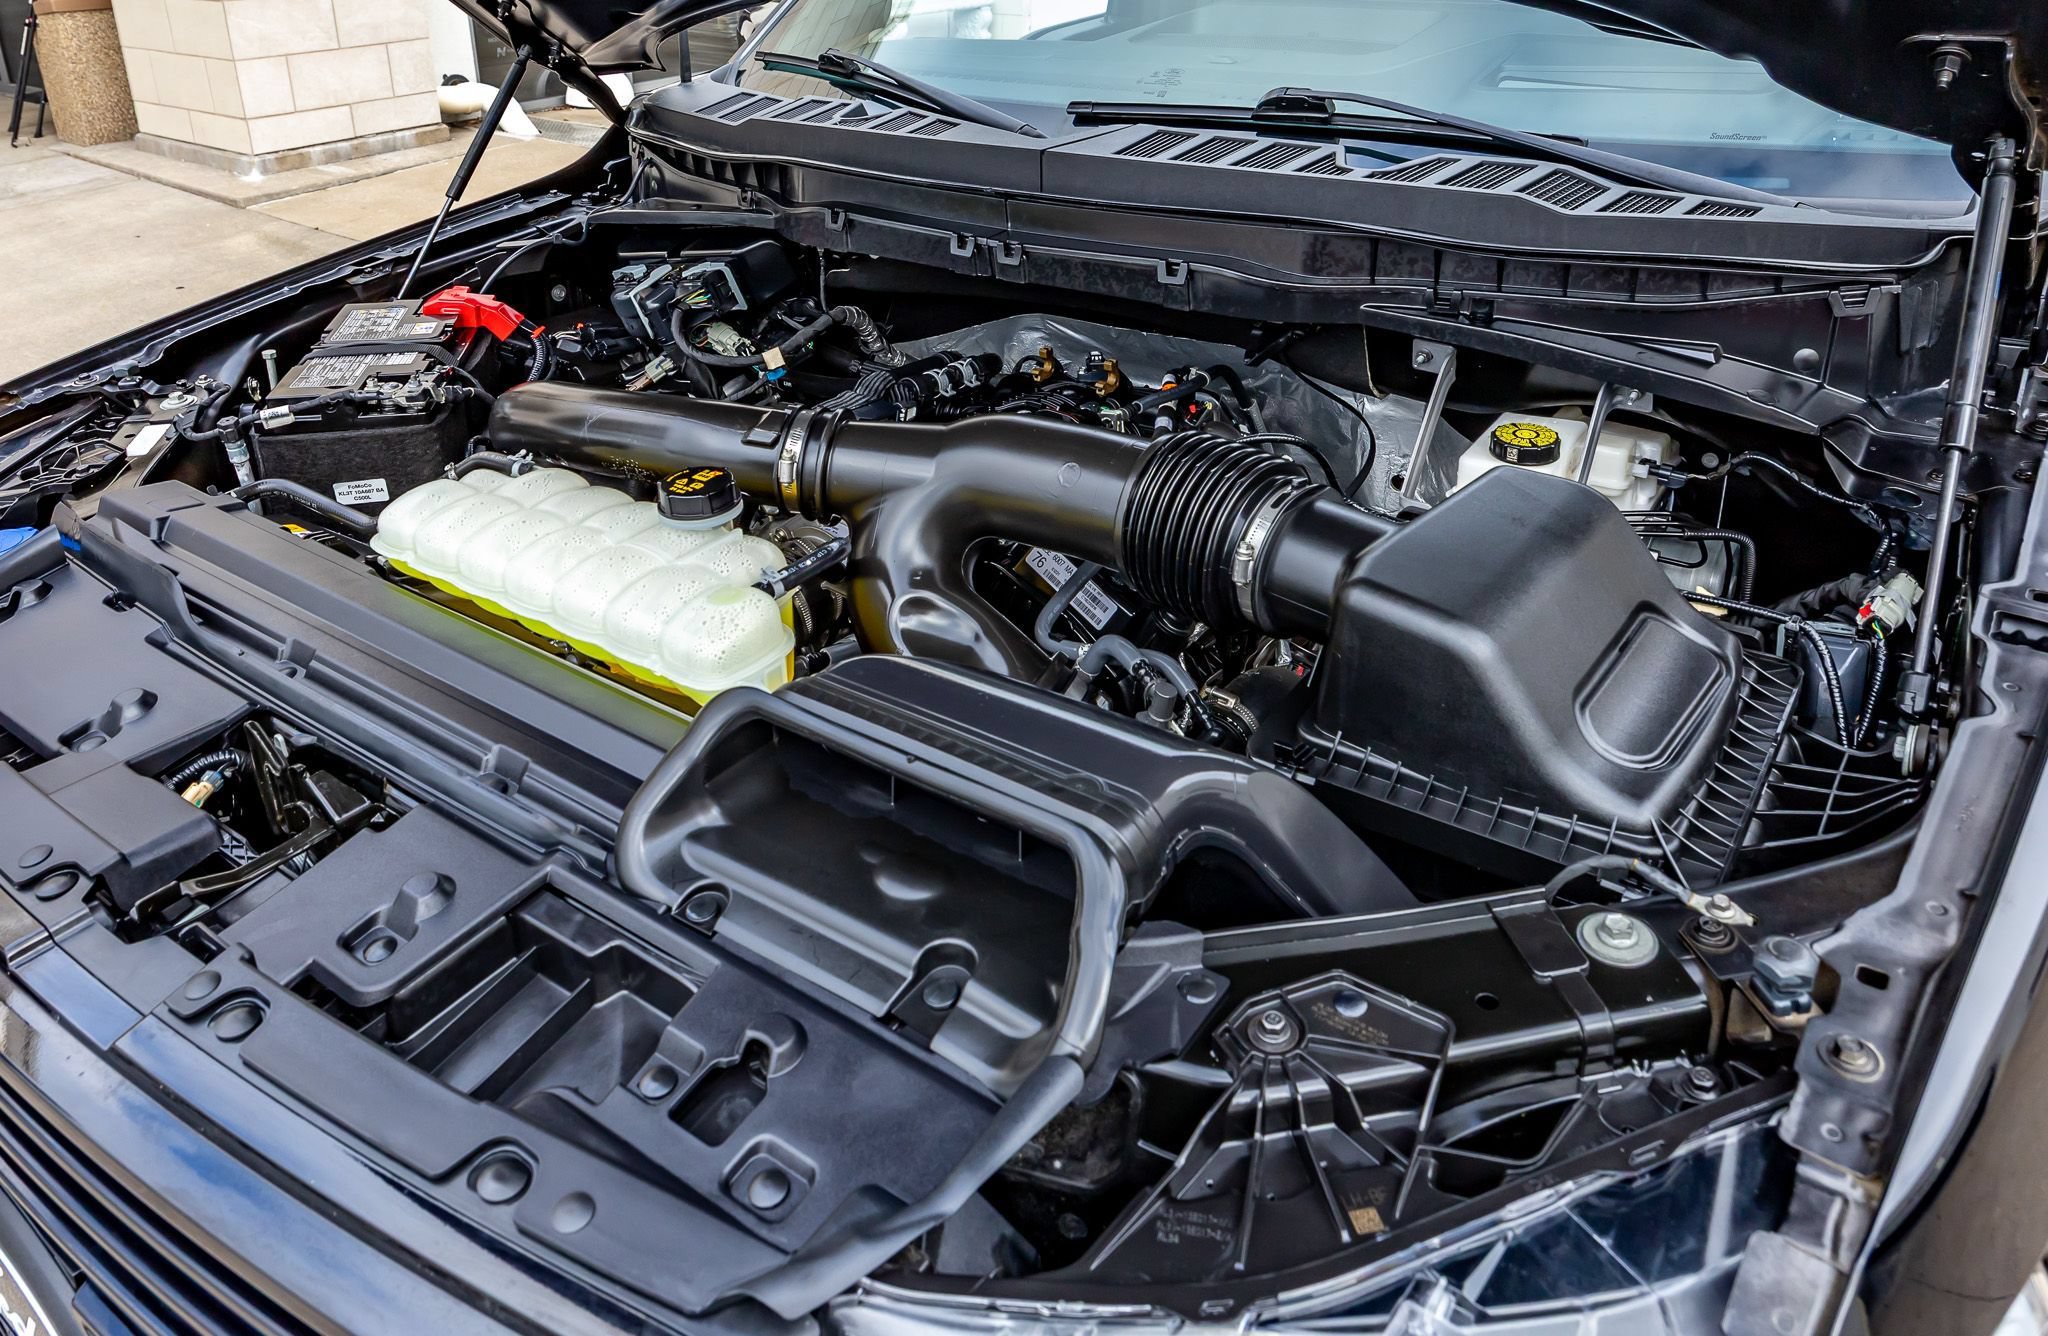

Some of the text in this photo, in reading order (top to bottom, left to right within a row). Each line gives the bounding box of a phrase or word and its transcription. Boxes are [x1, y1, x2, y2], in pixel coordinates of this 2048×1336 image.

[1709, 132, 1762, 141] SoundScreen
[1031, 551, 1047, 568] 76
[1052, 554, 1065, 566] 6007
